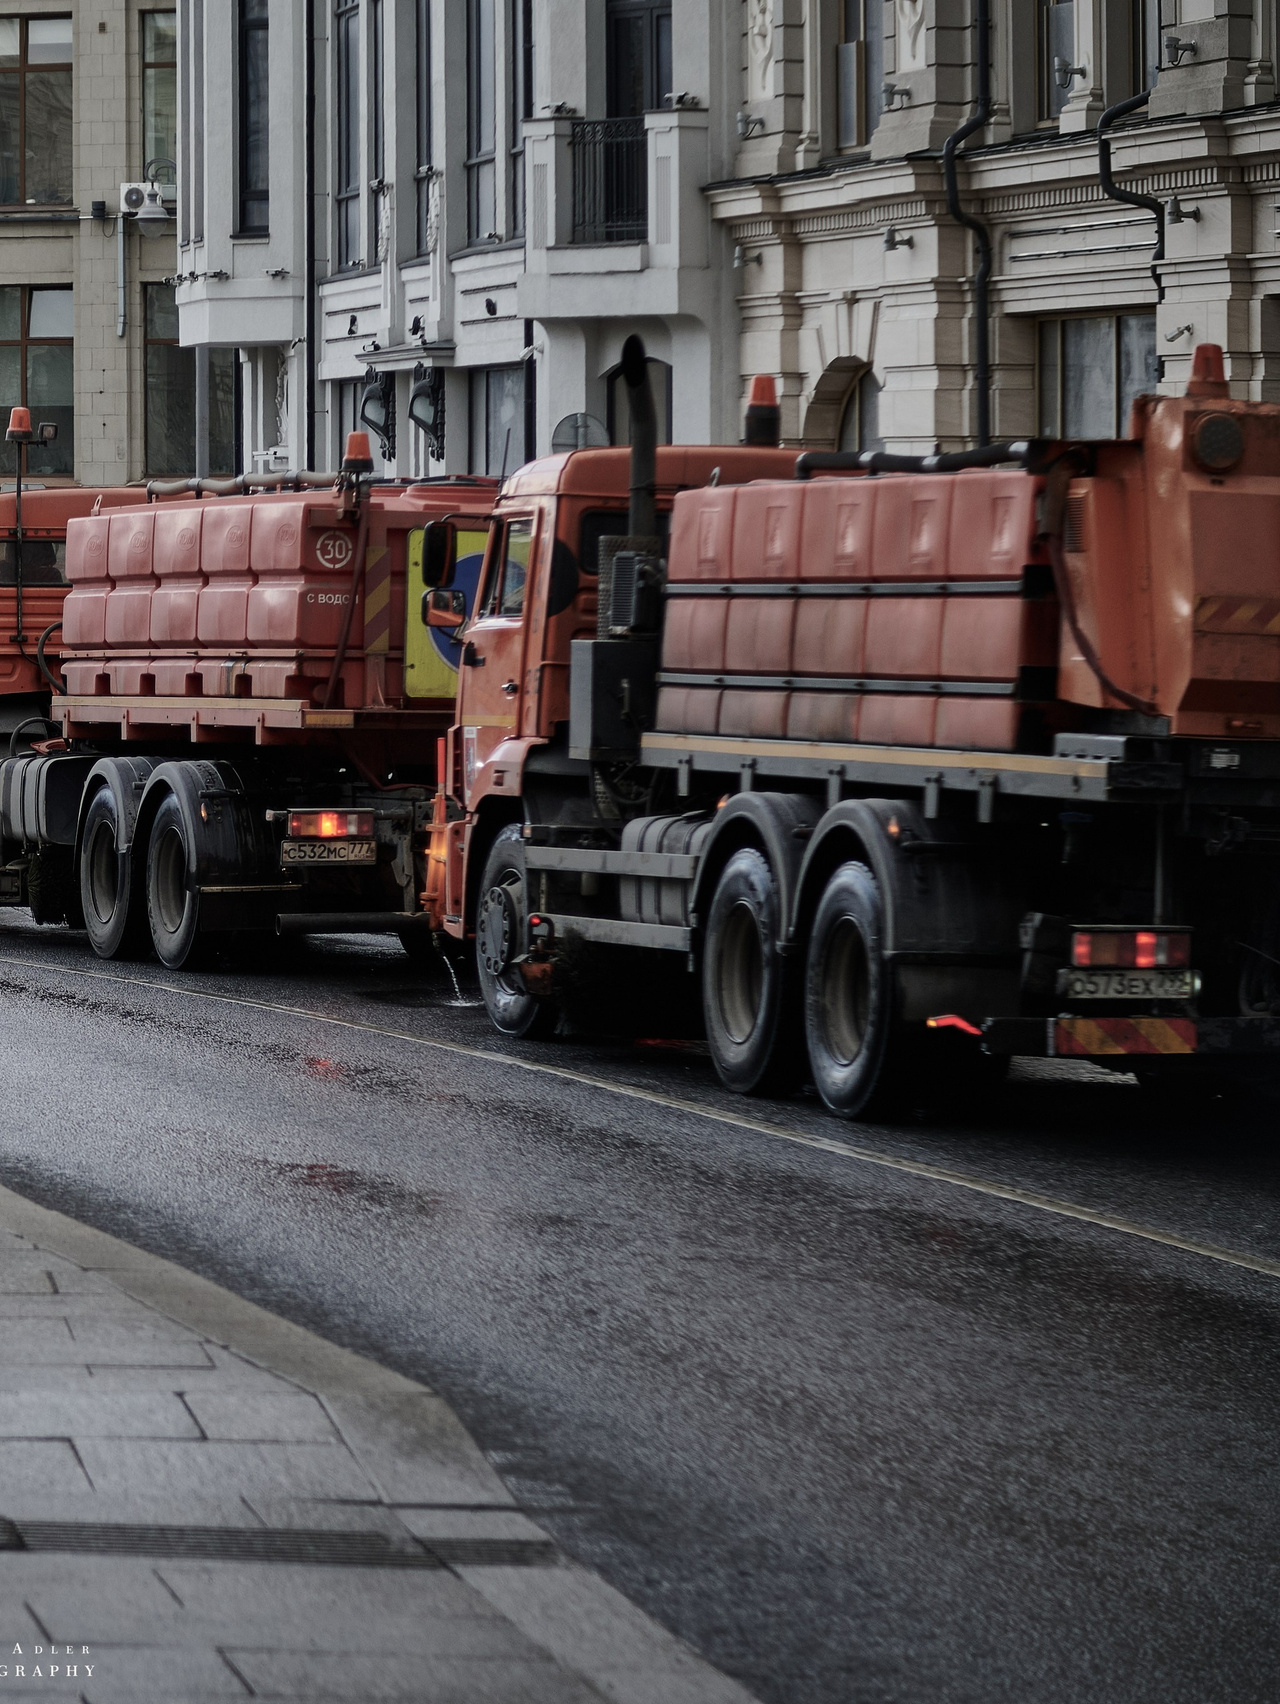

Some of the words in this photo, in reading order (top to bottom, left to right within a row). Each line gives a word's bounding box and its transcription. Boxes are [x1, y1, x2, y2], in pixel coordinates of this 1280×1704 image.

[324, 540, 347, 559] 30
[306, 593, 315, 604] С
[318, 593, 359, 606] ВОДО
